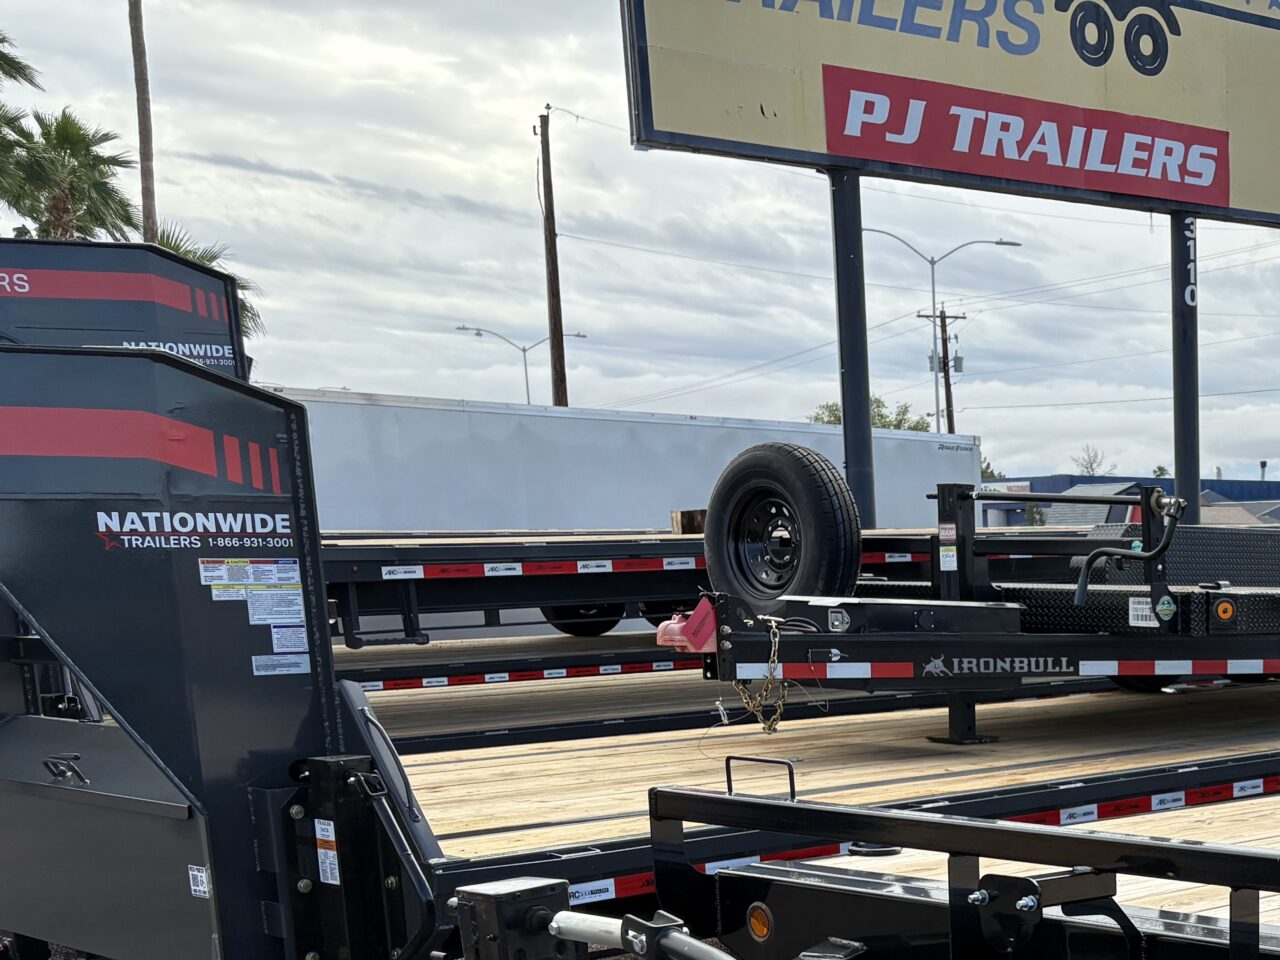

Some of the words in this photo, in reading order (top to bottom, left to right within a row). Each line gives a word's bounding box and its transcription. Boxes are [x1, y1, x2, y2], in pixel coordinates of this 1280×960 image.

[843, 90, 926, 145] PJ
[949, 106, 1218, 187] TRAILERS
[1184, 217, 1197, 307] 3110
[97, 511, 291, 533] NATIONWIDE
[121, 535, 201, 548] TRAILERS
[208, 537, 294, 548] 1-866-931-3001
[952, 657, 1074, 674] IRONBULL
